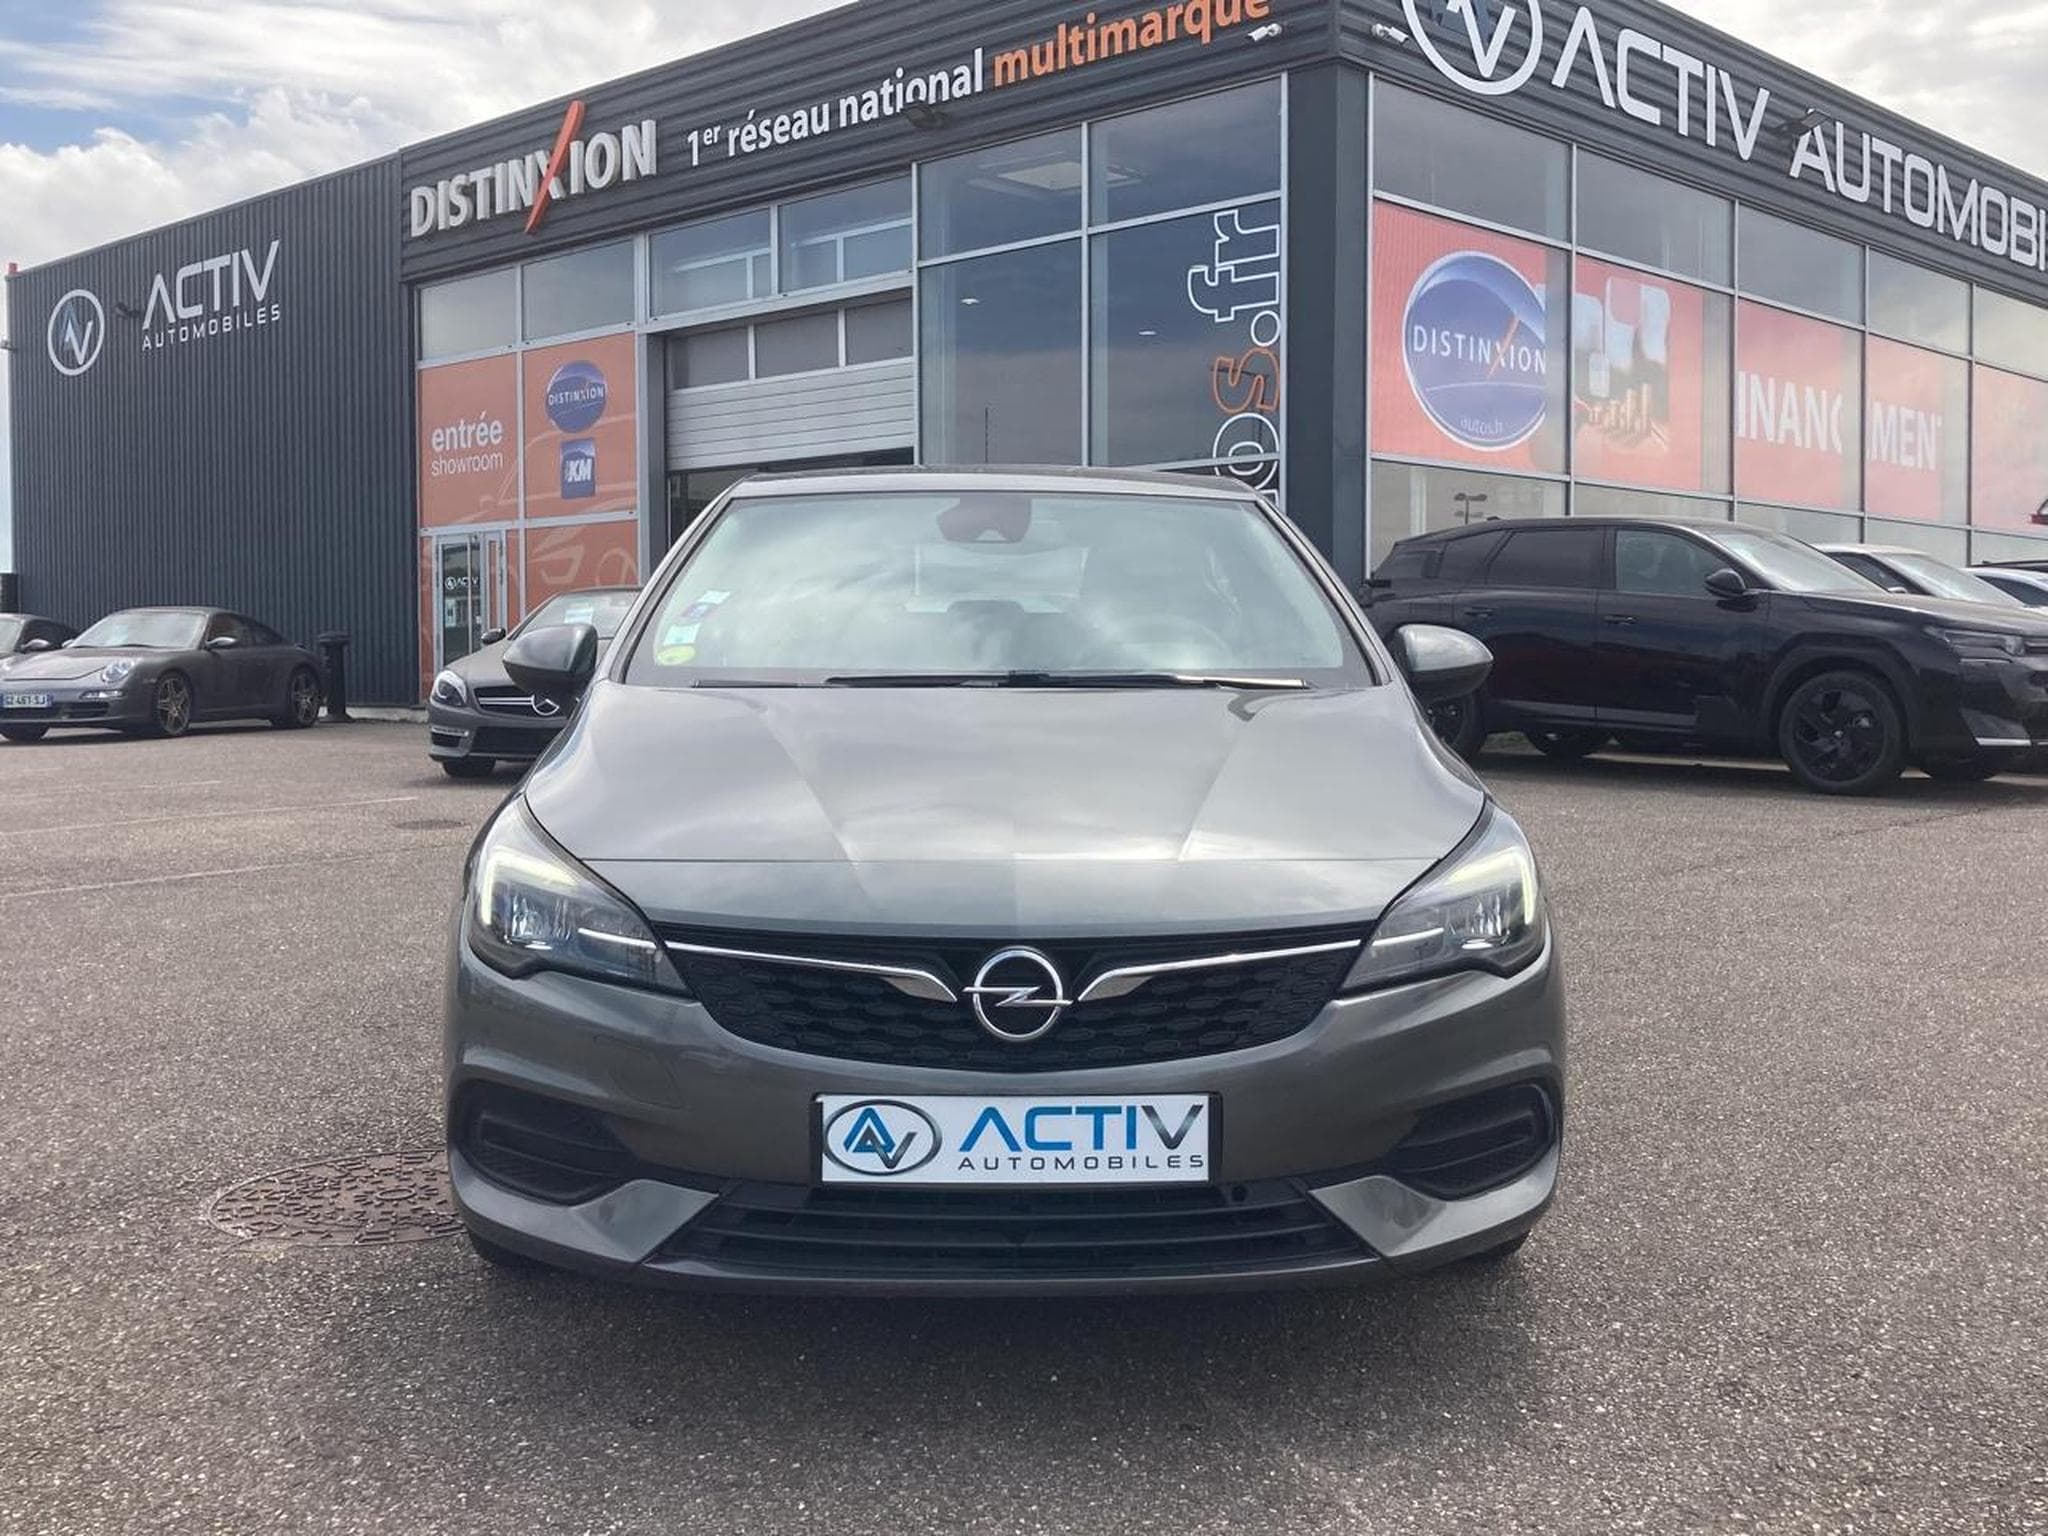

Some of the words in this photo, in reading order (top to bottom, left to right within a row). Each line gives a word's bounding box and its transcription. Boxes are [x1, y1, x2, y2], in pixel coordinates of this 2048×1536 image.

[728, 109, 830, 157] réseau
[838, 47, 983, 128] national
[1551, 6, 1771, 162] ACTIV
[1788, 120, 2047, 272] AUTOMOBI
[410, 98, 658, 238] DISTINXION
[141, 240, 281, 330] ACTIV
[141, 303, 282, 352] AUTOMOBILES
[1412, 318, 1546, 379] DISTINXION
[431, 410, 504, 451] entrée
[431, 450, 504, 477] showroom
[957, 1104, 1204, 1153] ACTIV
[957, 1153, 1205, 1171] AUTOMOBILES
